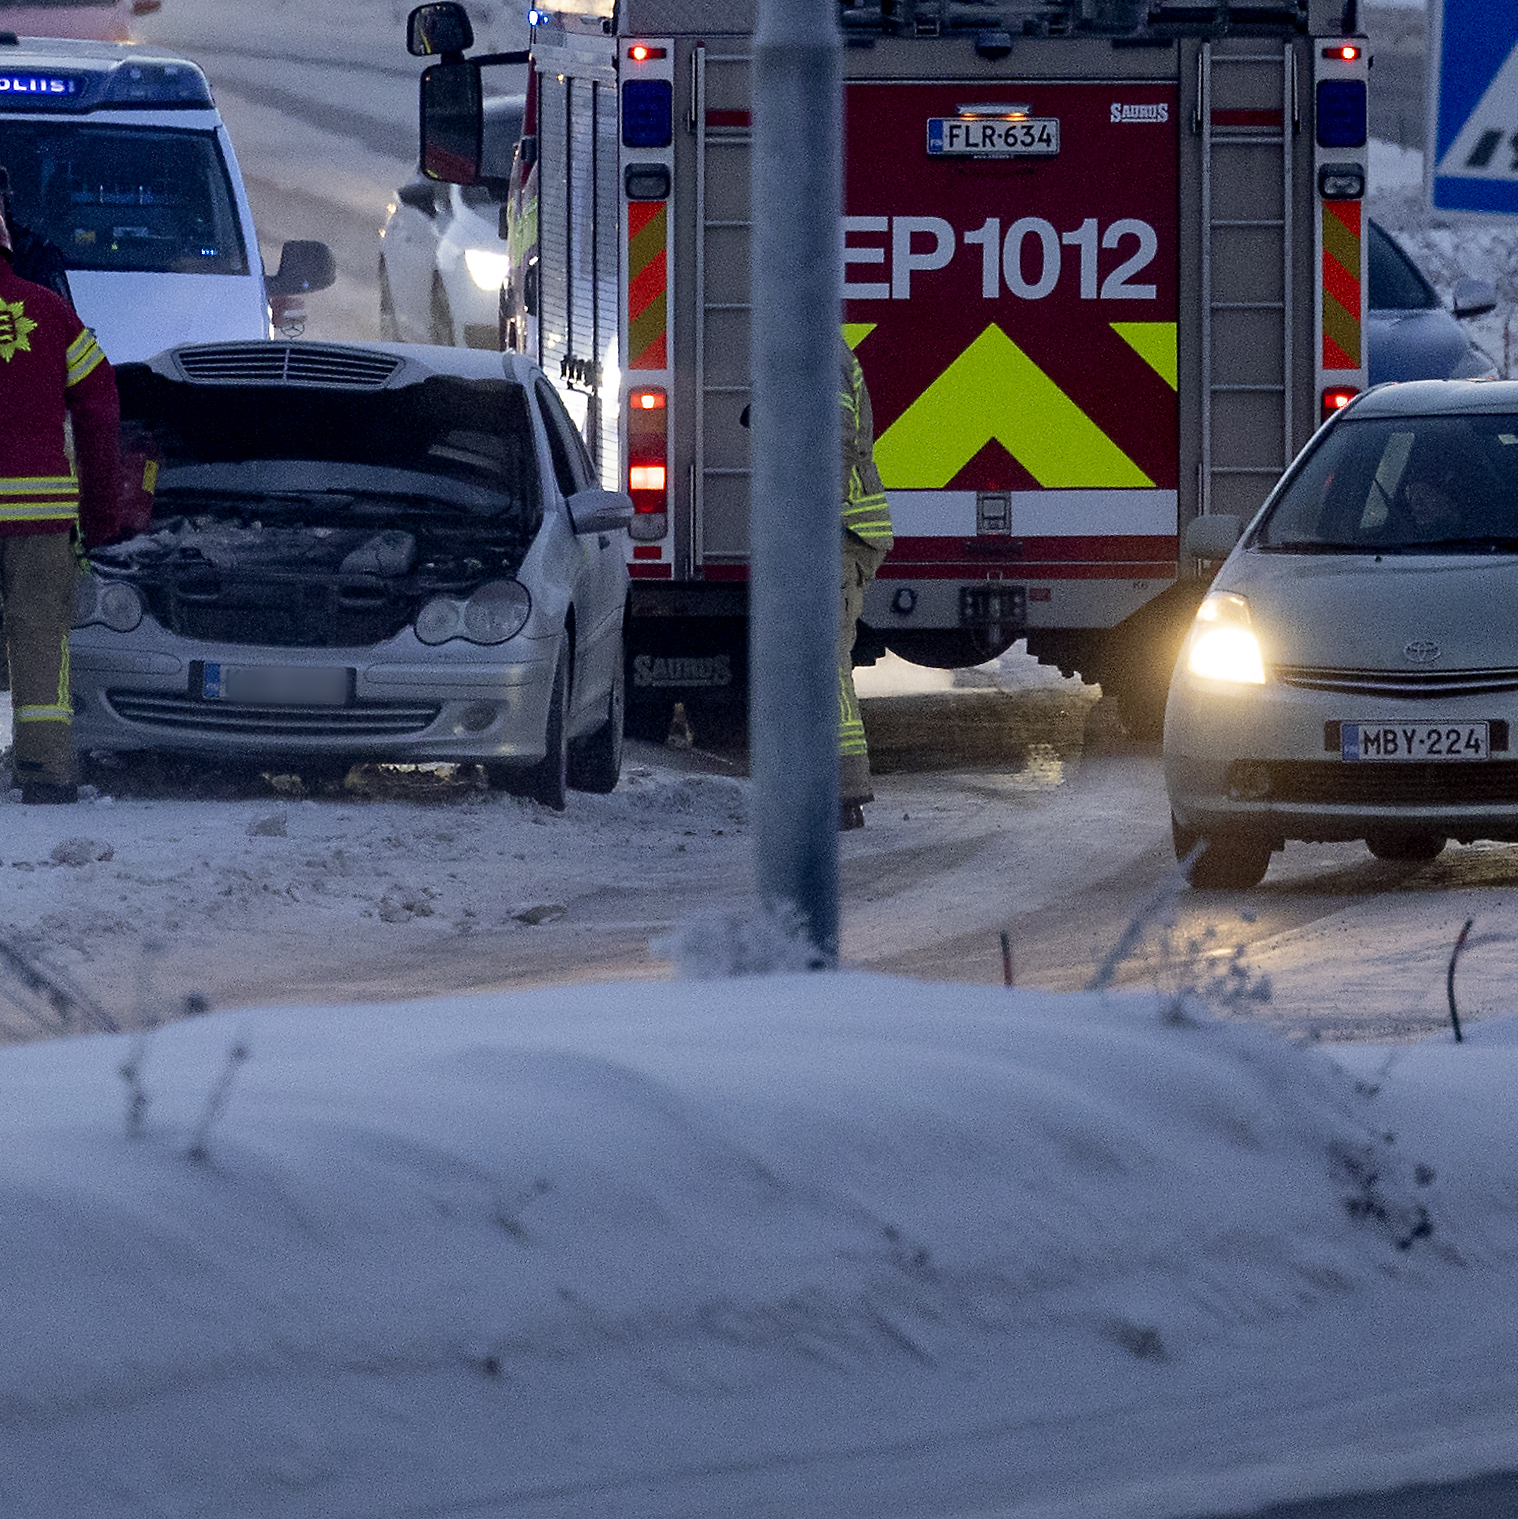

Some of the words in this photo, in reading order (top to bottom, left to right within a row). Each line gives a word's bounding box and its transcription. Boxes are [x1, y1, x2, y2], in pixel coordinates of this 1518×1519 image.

[1110, 103, 1169, 123] SAURUS
[948, 125, 1052, 148] FLR-634
[1363, 728, 1482, 755] MBY-224
